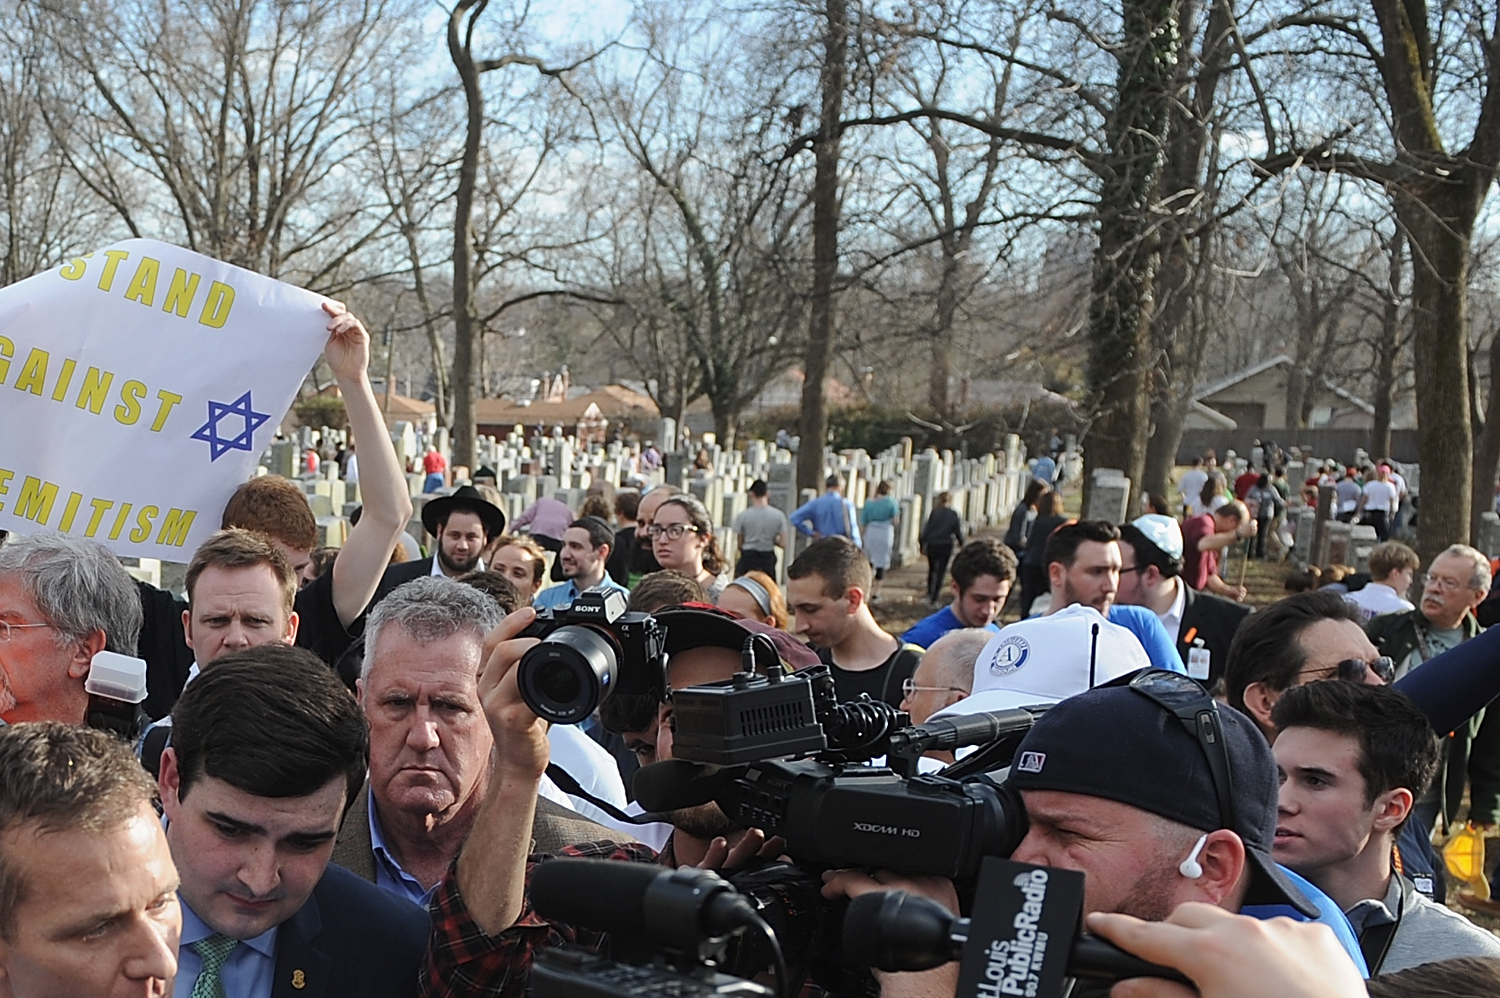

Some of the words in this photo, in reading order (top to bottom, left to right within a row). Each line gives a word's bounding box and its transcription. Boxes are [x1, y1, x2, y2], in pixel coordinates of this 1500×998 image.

[60, 250, 235, 328] STAND
[575, 605, 601, 613] SONY
[853, 822, 898, 835] XDCAM
[902, 828, 920, 838] HD
[1031, 931, 1049, 971] KWMU
